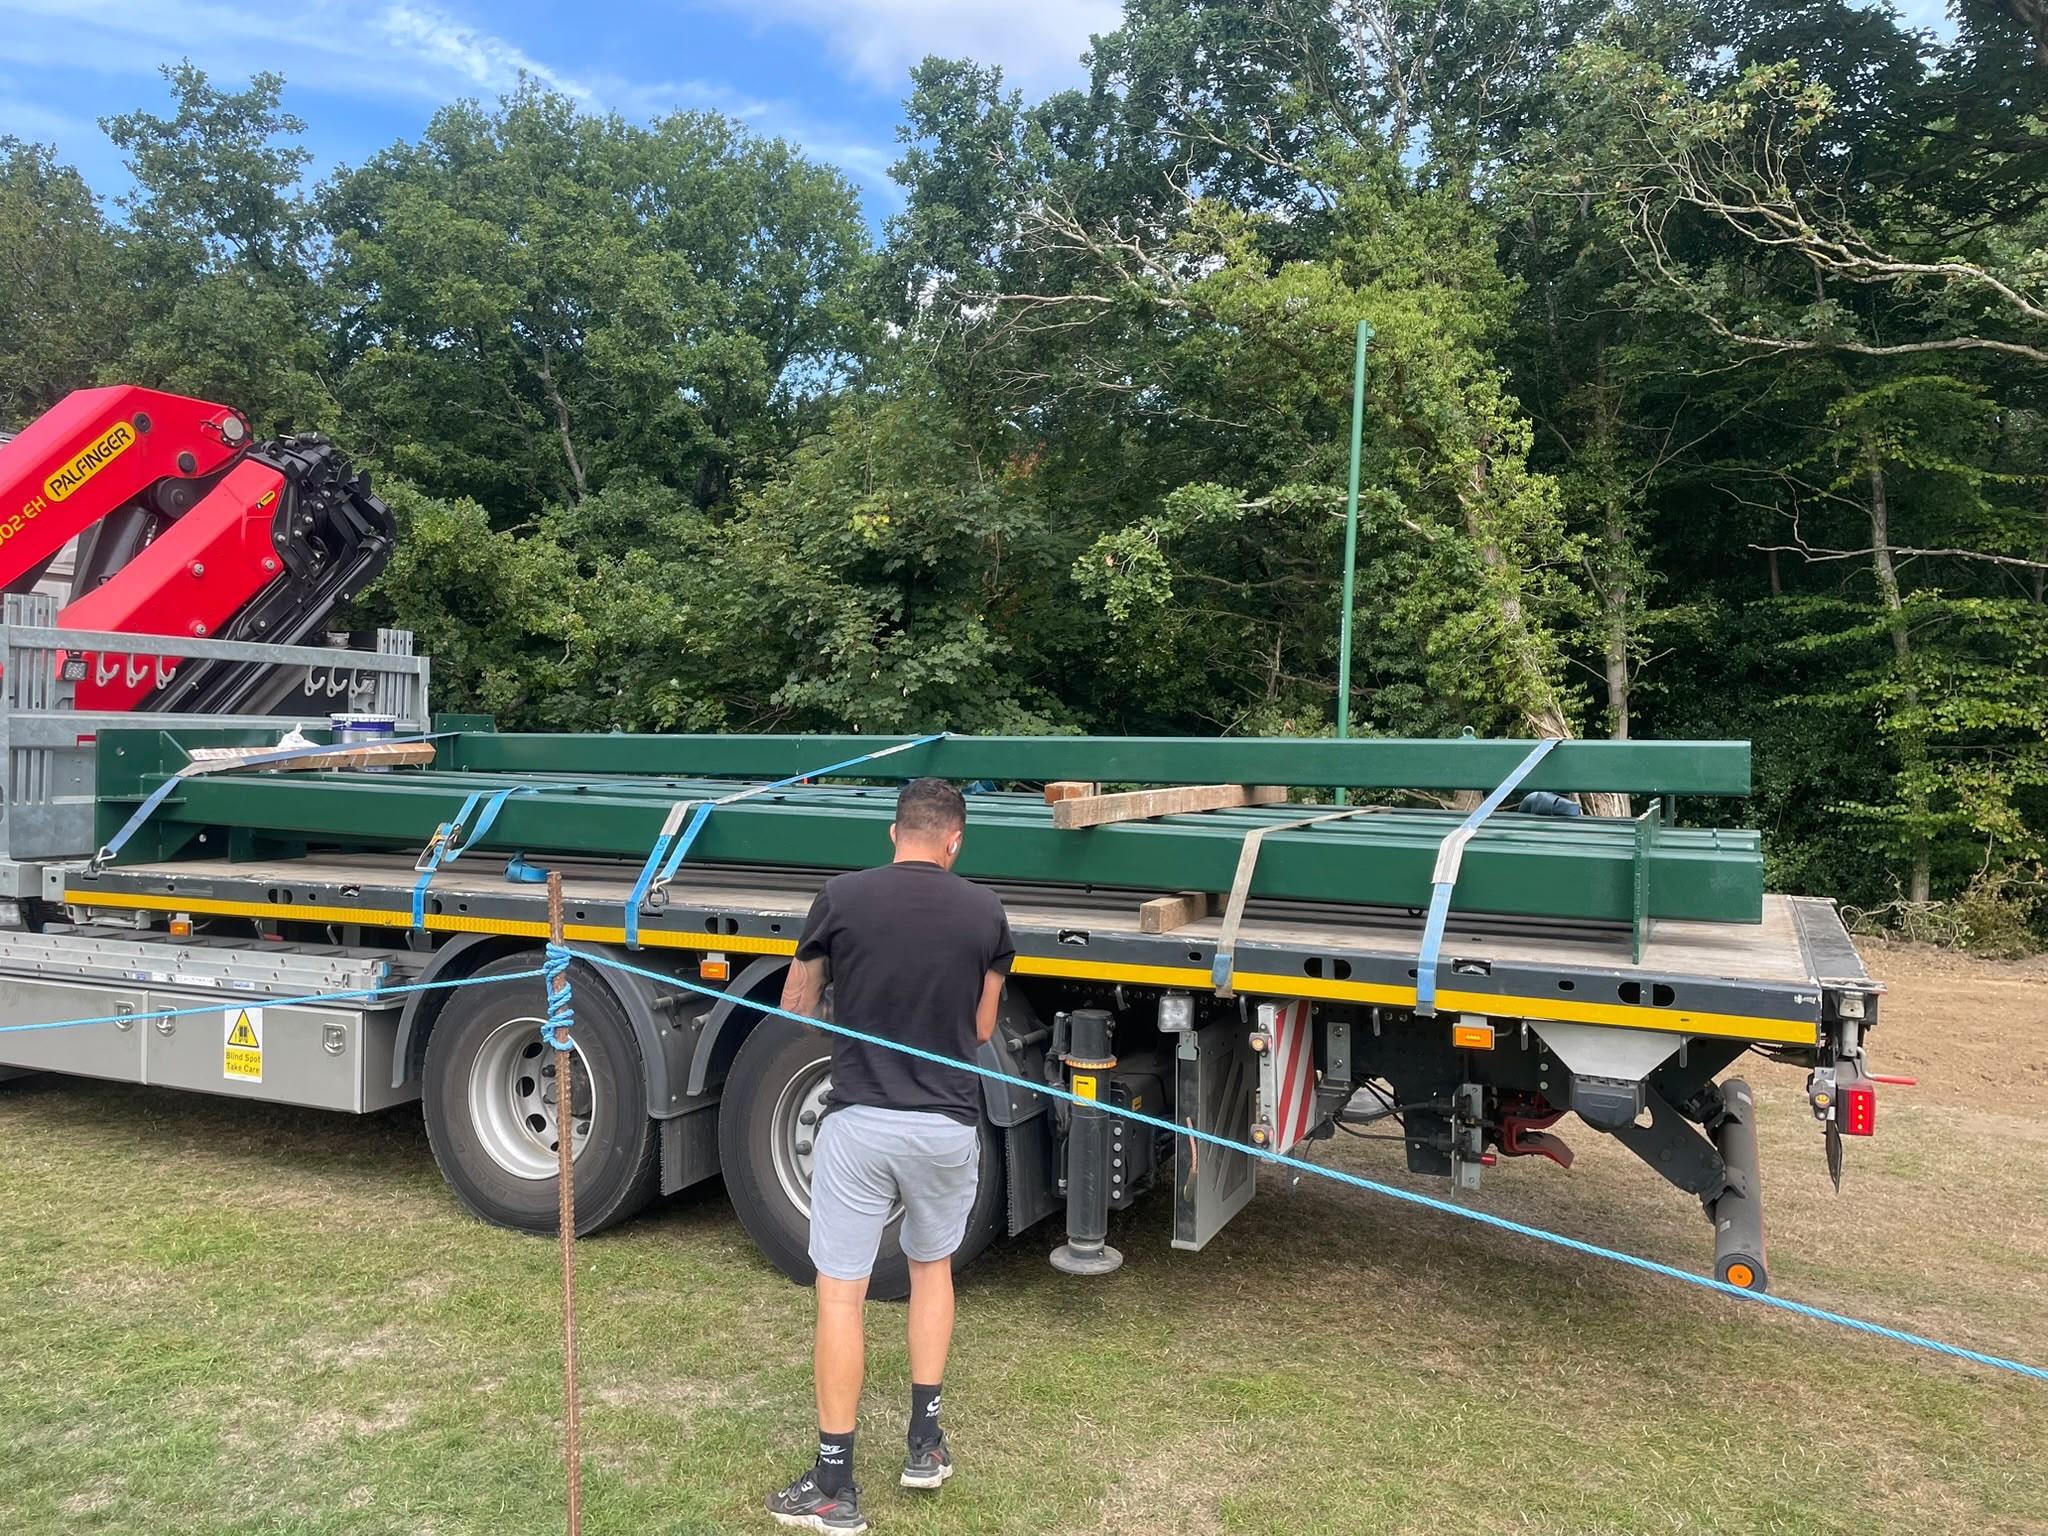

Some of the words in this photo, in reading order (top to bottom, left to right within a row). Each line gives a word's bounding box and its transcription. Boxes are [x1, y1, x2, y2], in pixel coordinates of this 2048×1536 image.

[49, 427, 131, 497] PALFINGER
[226, 1051, 243, 1061] Blind
[245, 1054, 261, 1063] Spot
[226, 1062, 242, 1072] Take
[244, 1064, 260, 1073] Care
